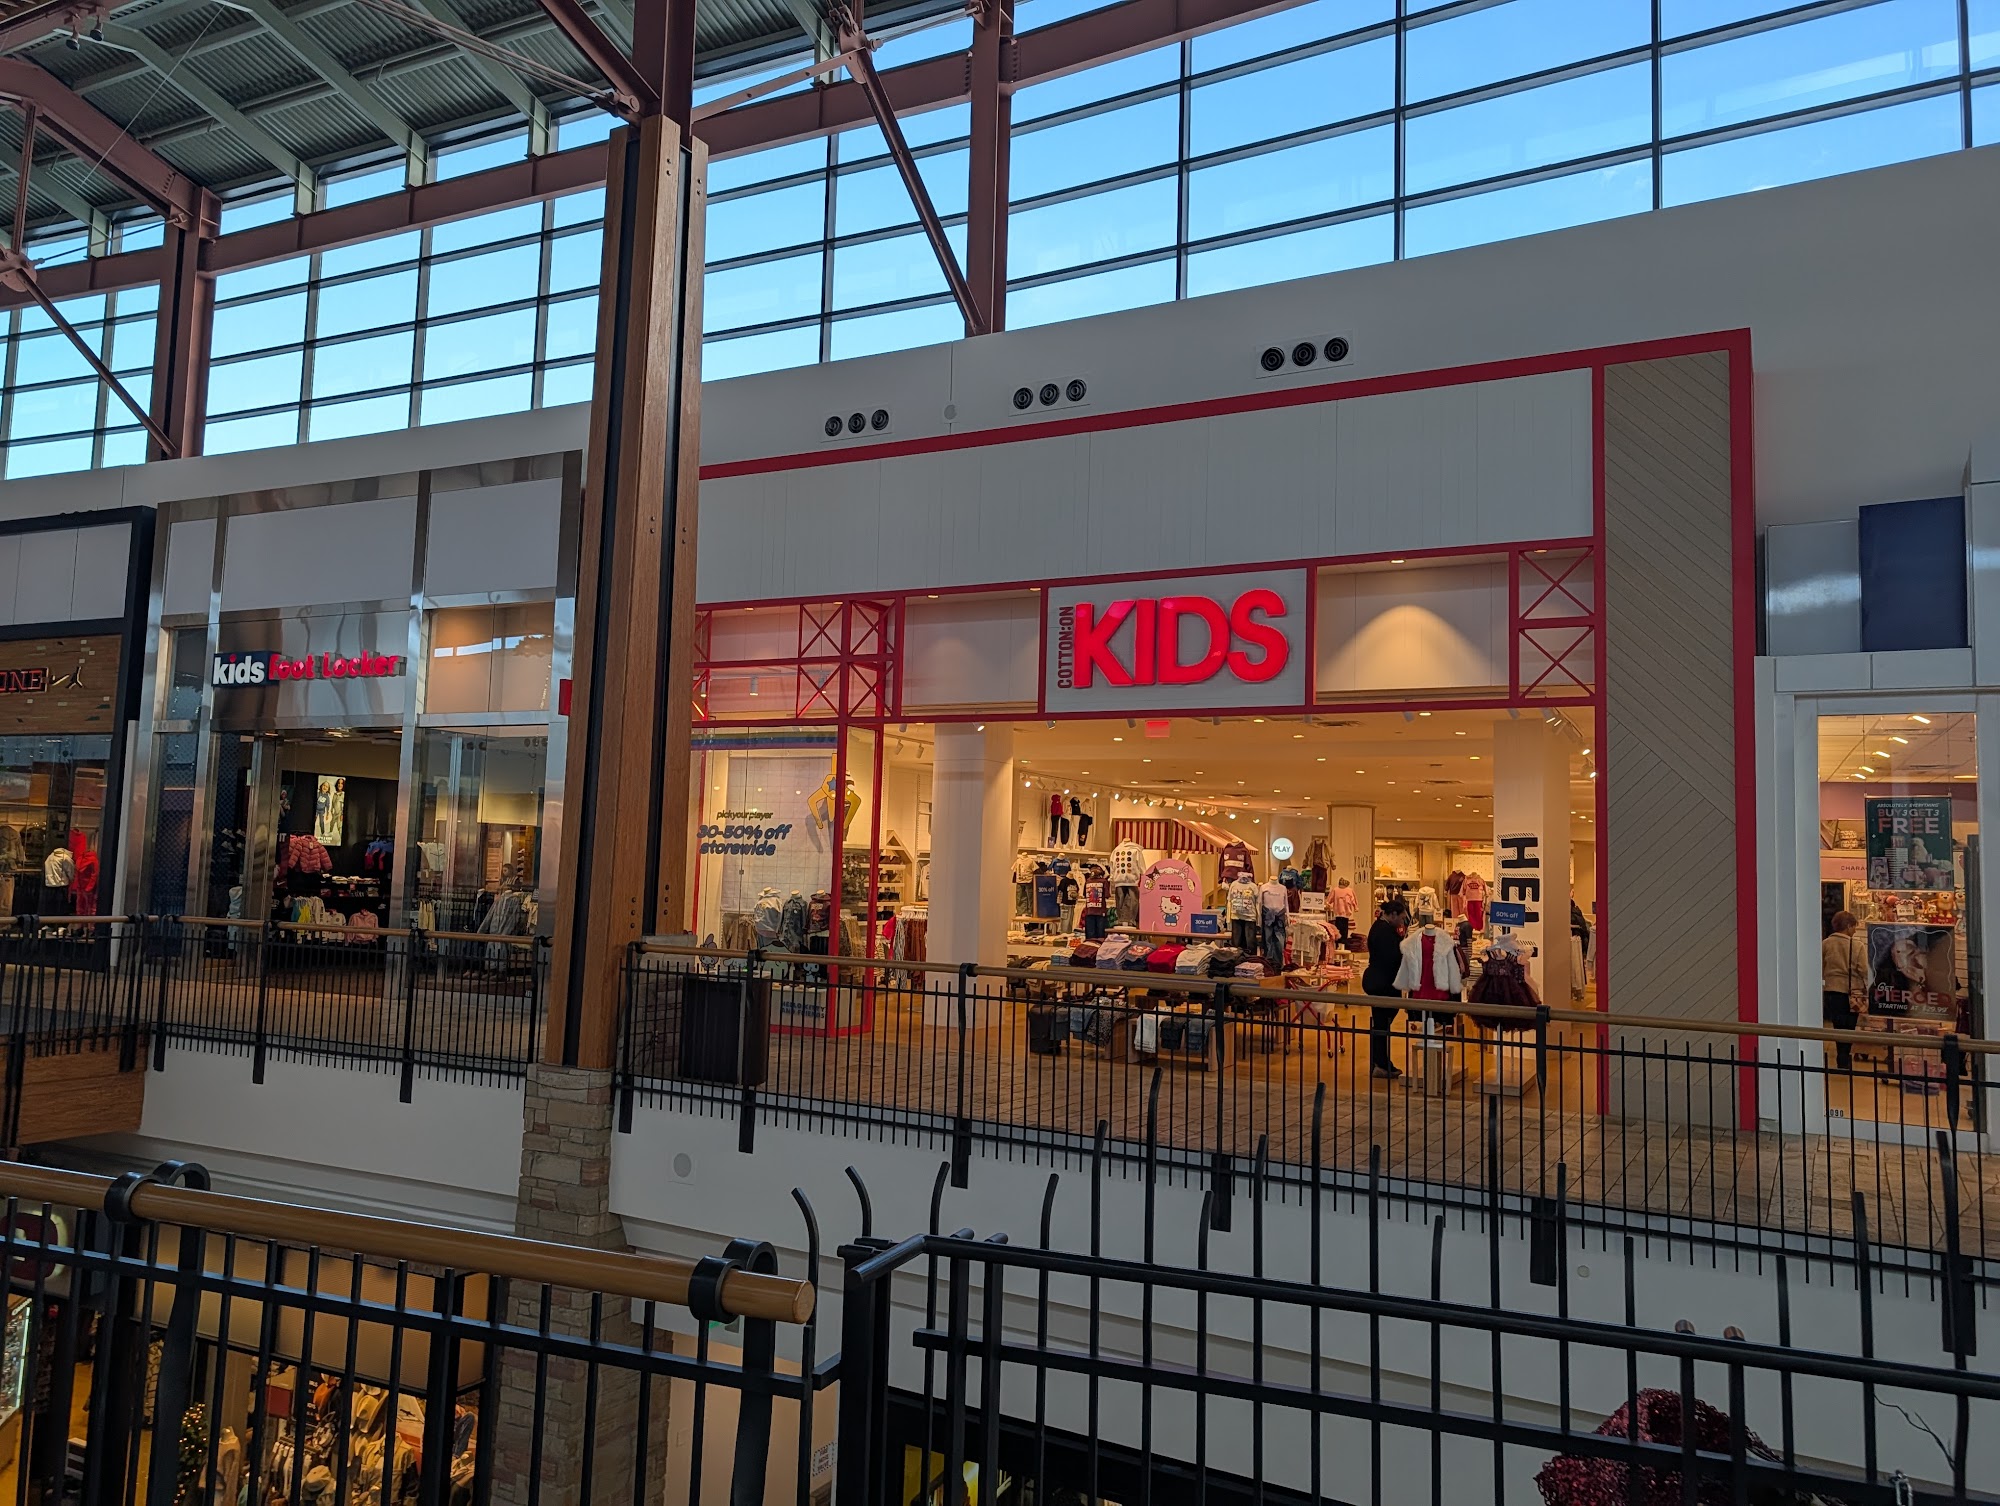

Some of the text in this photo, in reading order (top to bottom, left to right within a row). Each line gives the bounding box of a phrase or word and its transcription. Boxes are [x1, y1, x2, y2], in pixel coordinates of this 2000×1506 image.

[1073, 588, 1289, 688] KIDS
[1057, 606, 1074, 689] COTTON:ON
[213, 650, 399, 685] kids Foot Locker
[1878, 809, 1940, 817] BUY 3 GET 3
[696, 824, 792, 840] 30-50% off
[1878, 817, 1940, 834] FREE
[700, 840, 776, 856] storewide
[1274, 845, 1291, 853] PLAY
[1874, 988, 1952, 1006] PIERCED
[1878, 1002, 1908, 1010] STARTING
[1824, 1109, 1845, 1117] 090
